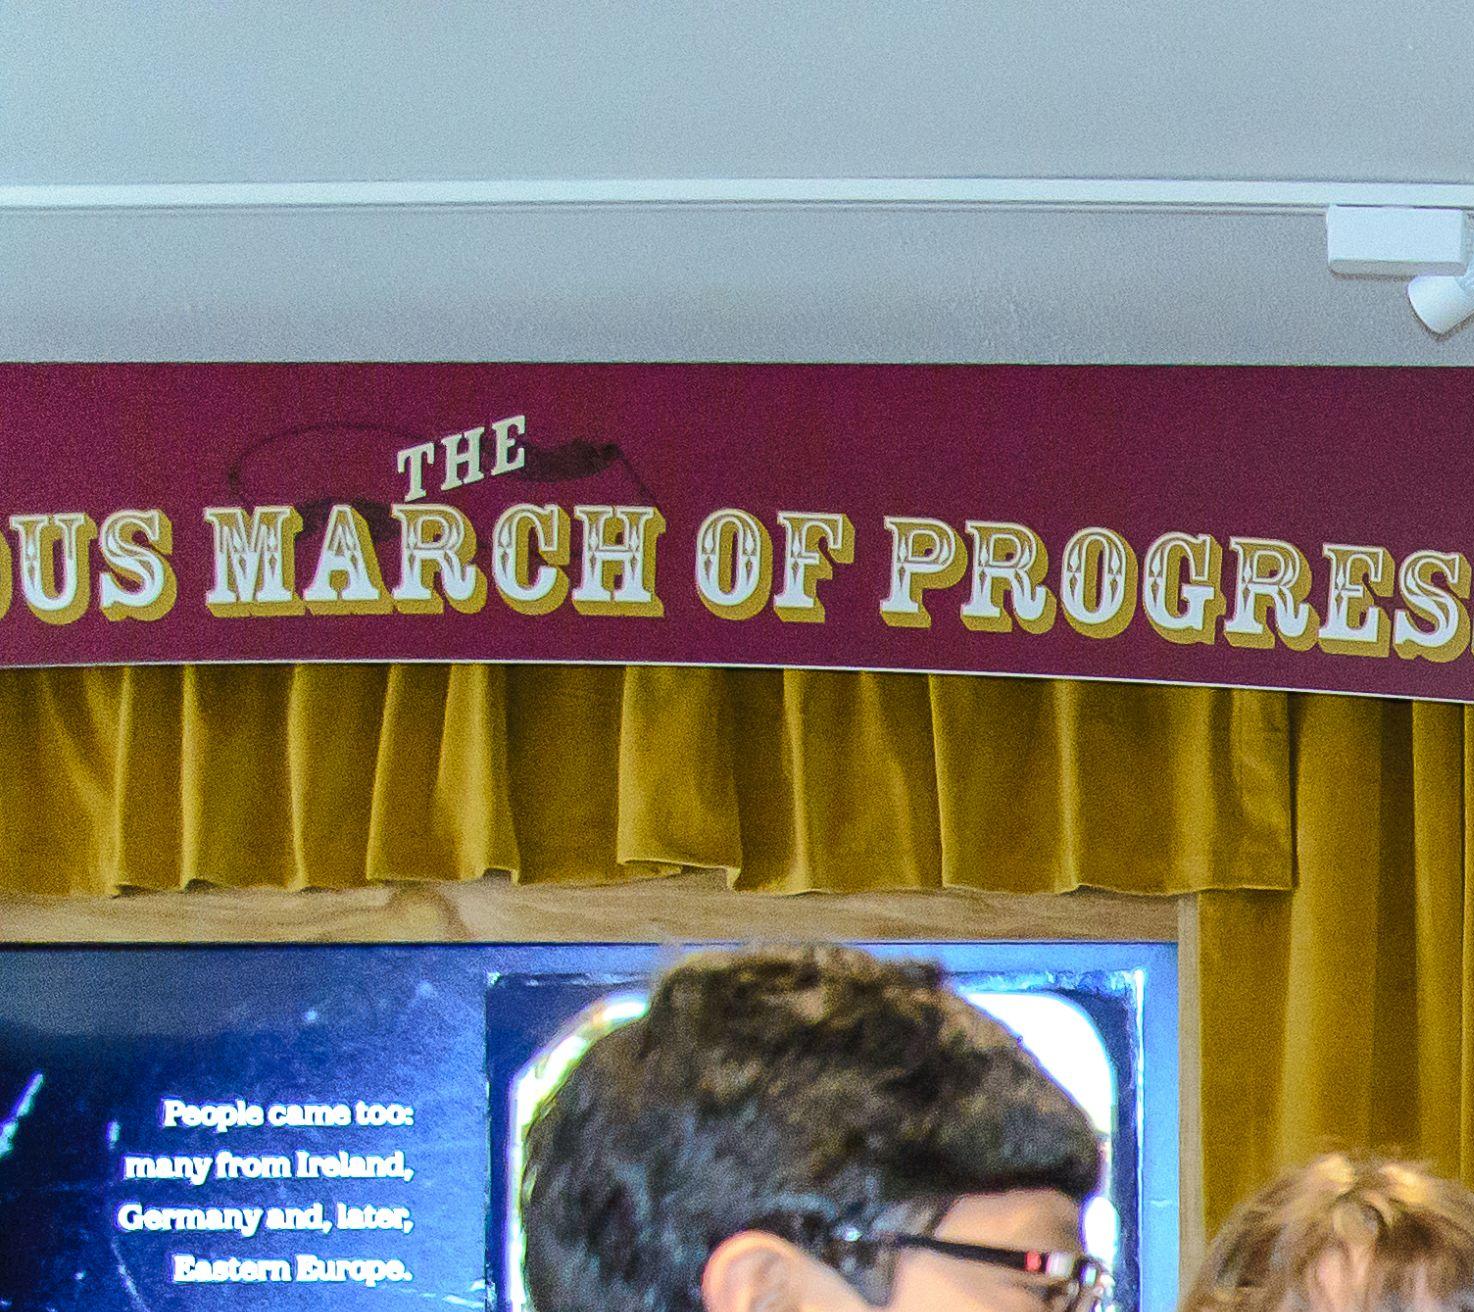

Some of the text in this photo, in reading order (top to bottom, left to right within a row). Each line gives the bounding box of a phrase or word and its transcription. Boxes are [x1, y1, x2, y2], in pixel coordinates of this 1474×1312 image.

[397, 415, 527, 502] THE
[0, 508, 178, 625] US
[204, 504, 667, 619] MARCH
[695, 509, 855, 623] OF
[163, 1099, 414, 1132] People came too:
[125, 1151, 414, 1184] many from Ireland,
[118, 1203, 414, 1238] Germany and, later,
[173, 1255, 413, 1287] Eastern Europe.
